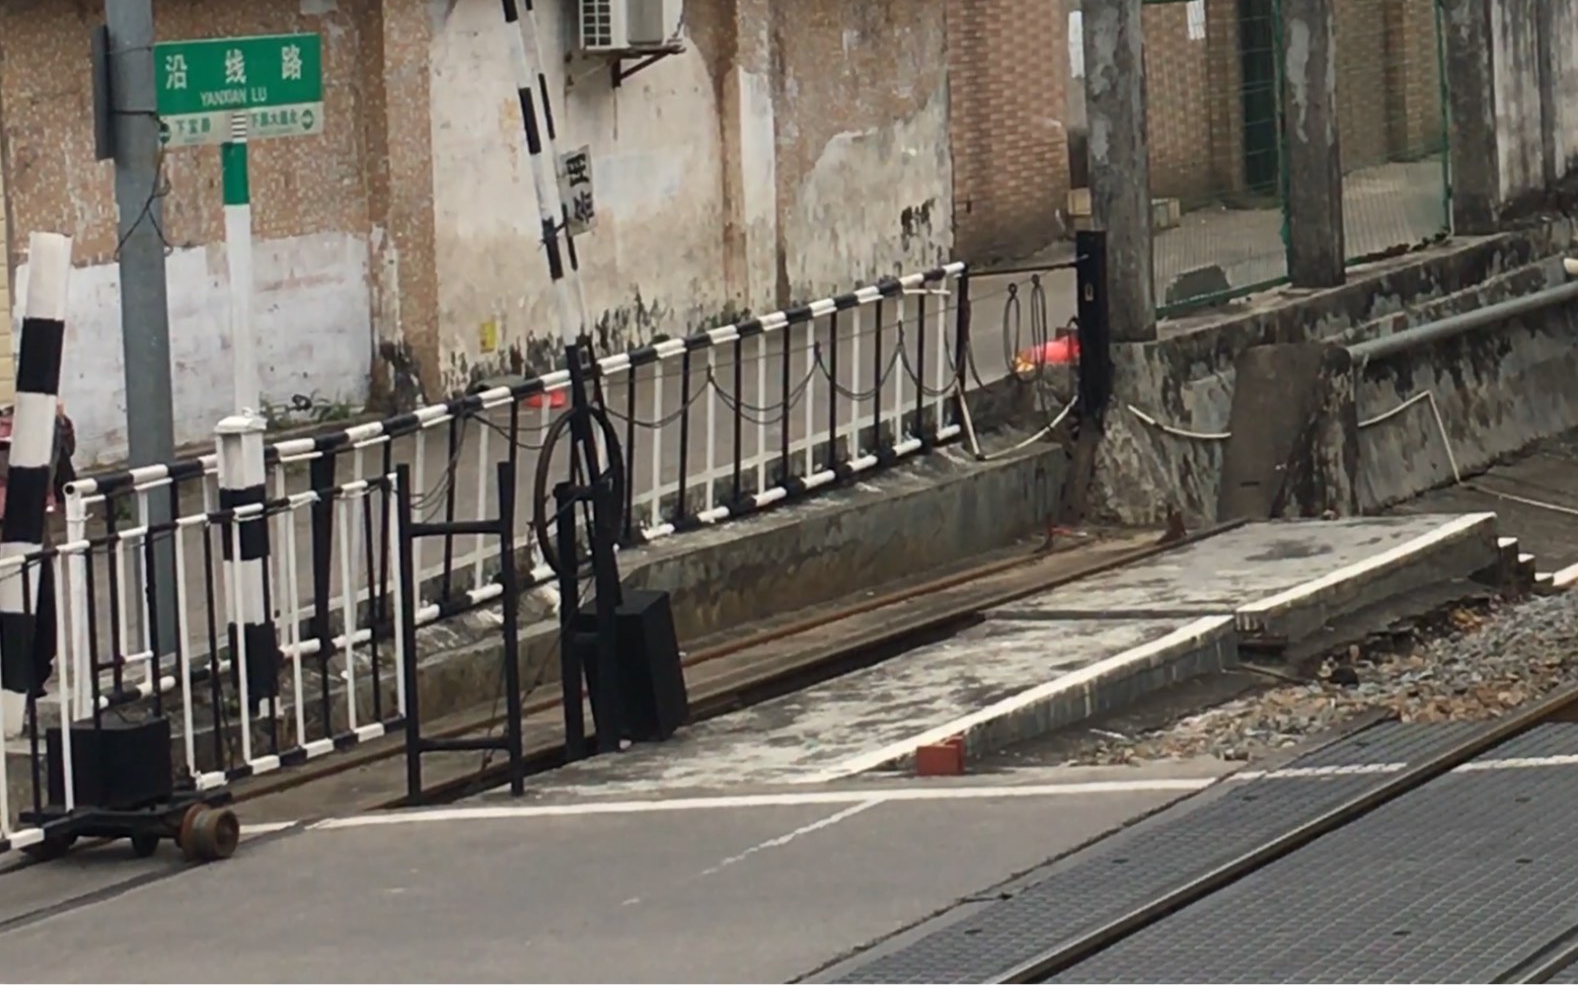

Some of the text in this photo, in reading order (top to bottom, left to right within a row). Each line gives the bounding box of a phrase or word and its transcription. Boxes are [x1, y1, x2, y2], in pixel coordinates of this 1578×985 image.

[165, 44, 302, 89] 沿线路
[200, 86, 267, 106] YANXIAN LU
